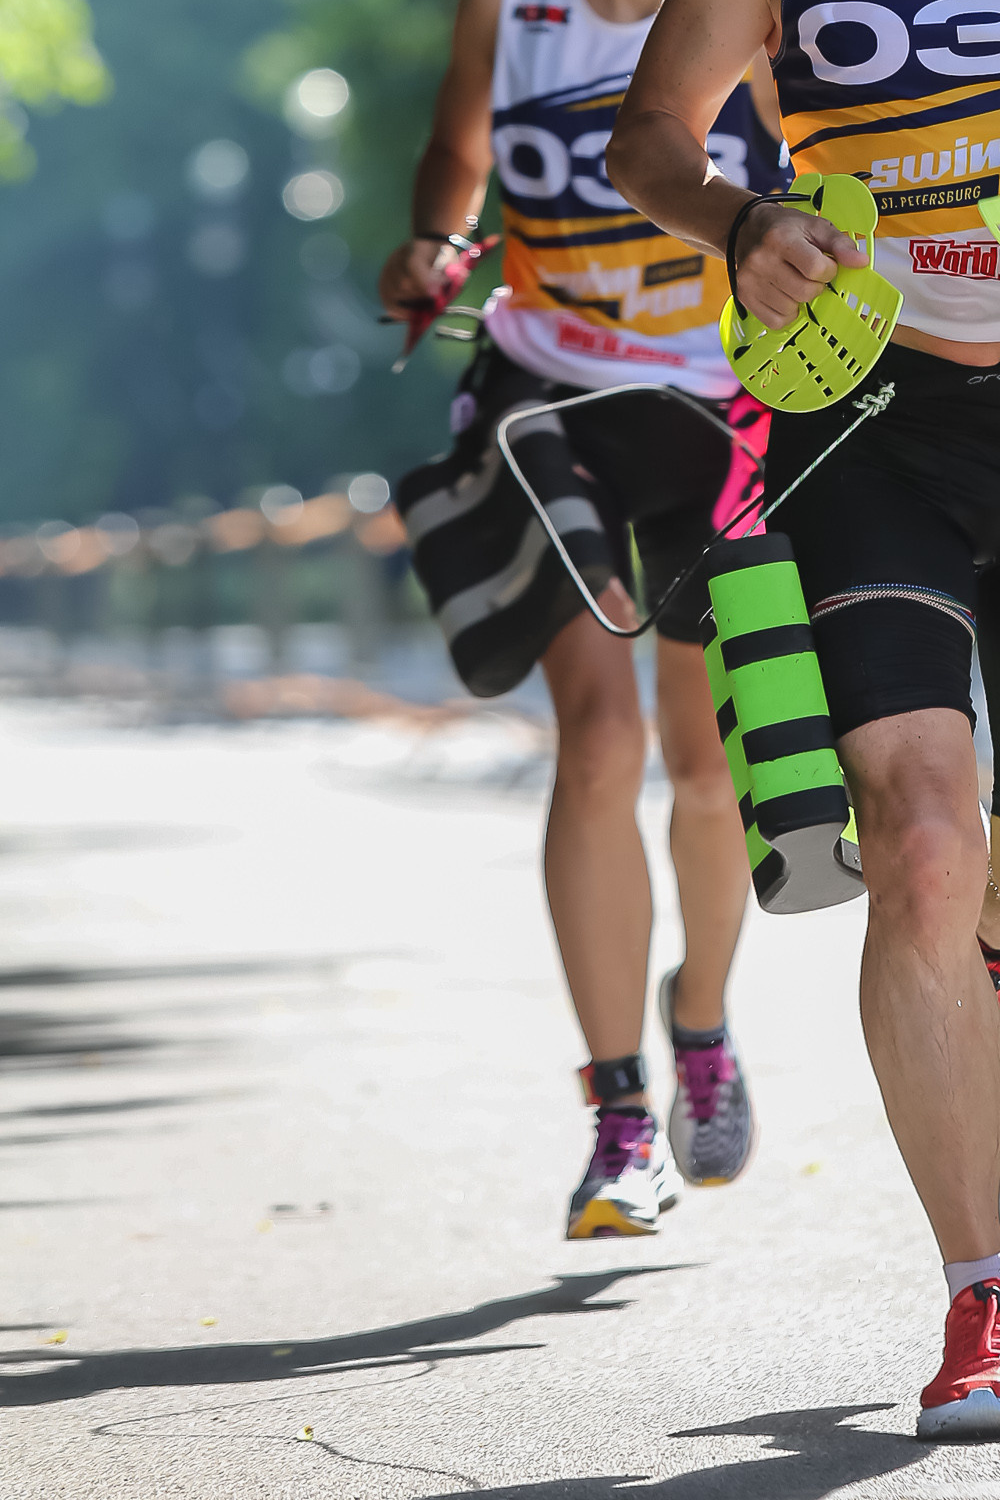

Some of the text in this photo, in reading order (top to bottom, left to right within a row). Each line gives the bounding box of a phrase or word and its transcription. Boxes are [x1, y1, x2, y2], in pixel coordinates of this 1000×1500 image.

[880, 185, 982, 210] ST. PETERSBURG
[915, 244, 998, 278] World
